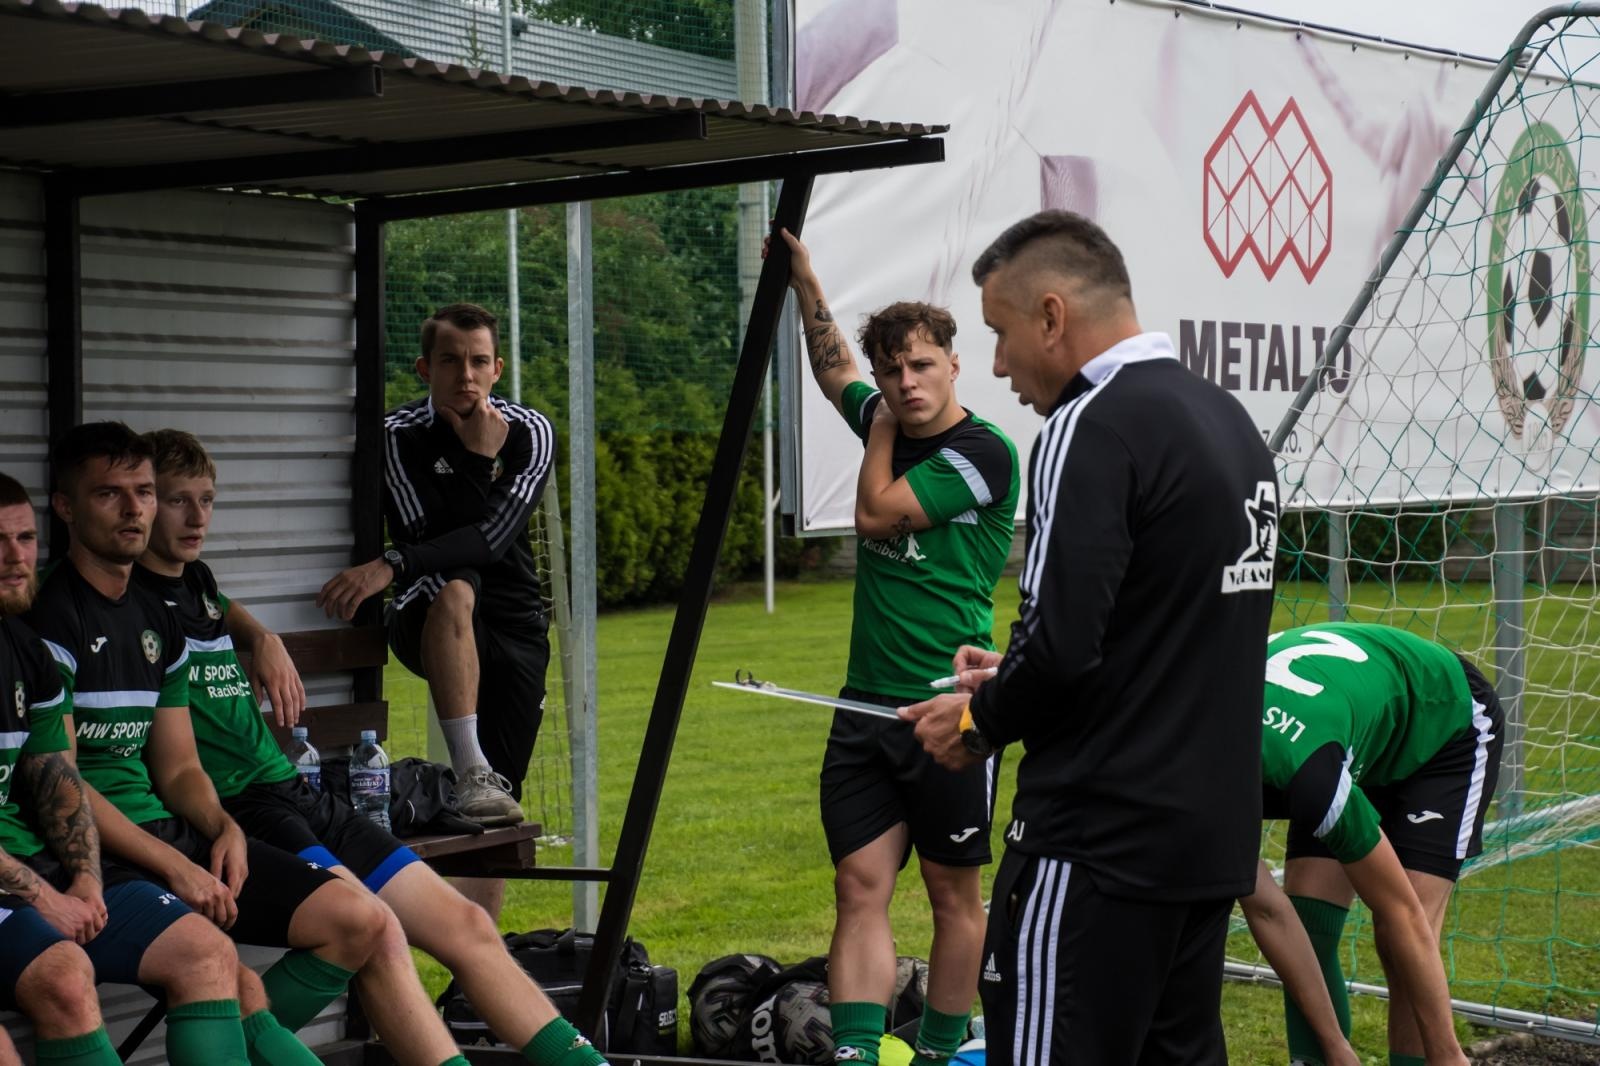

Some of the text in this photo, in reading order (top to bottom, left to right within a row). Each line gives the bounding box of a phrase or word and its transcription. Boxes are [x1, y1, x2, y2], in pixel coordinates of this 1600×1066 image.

[204, 663, 240, 681] SPORT
[76, 721, 150, 739] MW SPORT
[1262, 706, 1306, 743] LKS
[1007, 819, 1025, 842] AJ
